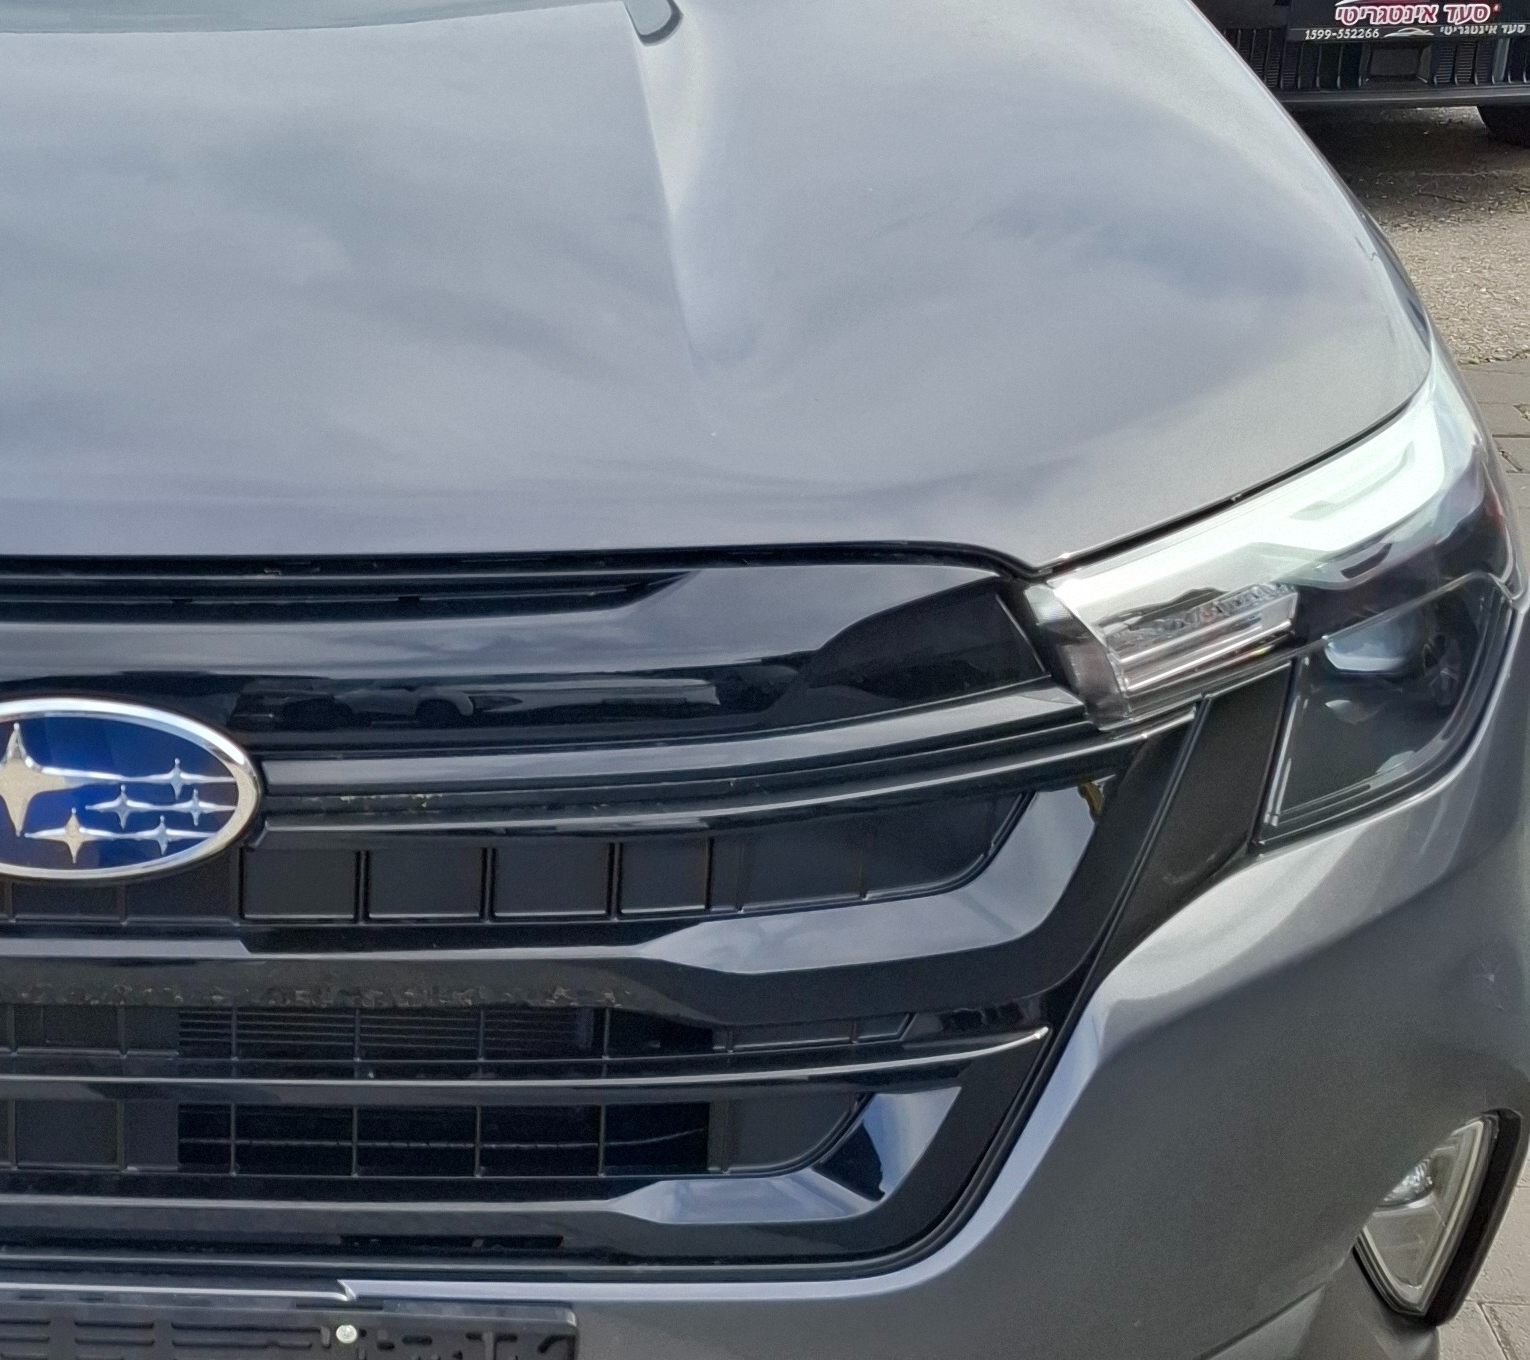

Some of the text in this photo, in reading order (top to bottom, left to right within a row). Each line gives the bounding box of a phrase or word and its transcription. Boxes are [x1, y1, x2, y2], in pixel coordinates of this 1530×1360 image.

[1335, 3, 1491, 26] סעד אינטגריטי
[1305, 28, 1380, 40] 1599-552266
[1440, 24, 1526, 36] סעד אינטגריטי
